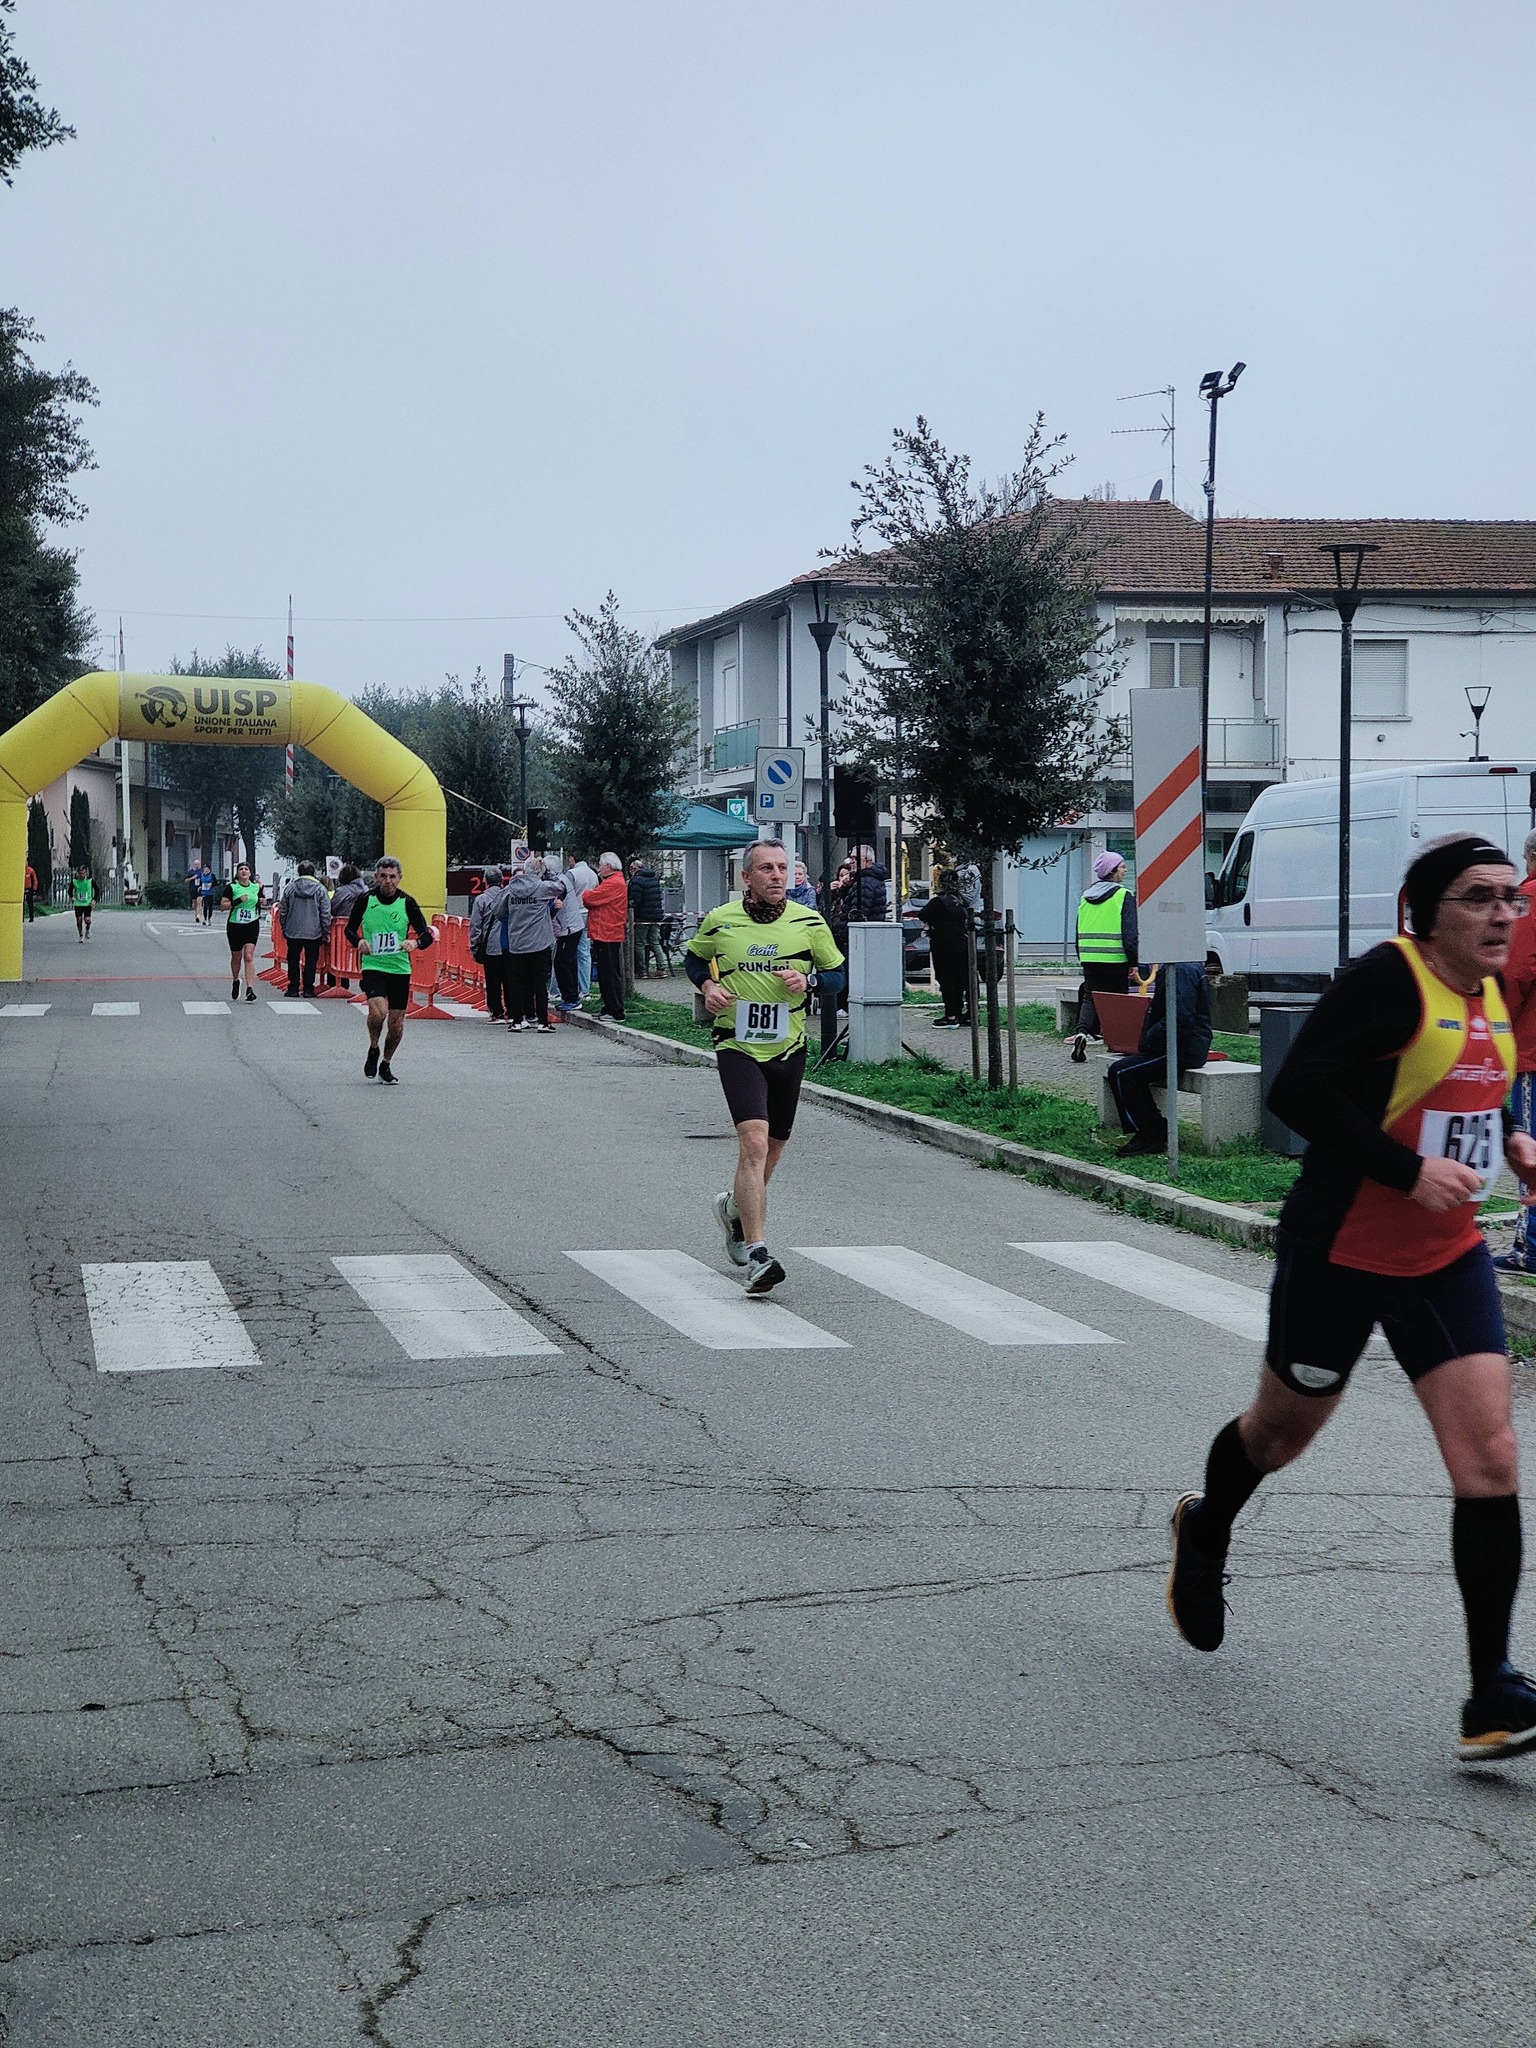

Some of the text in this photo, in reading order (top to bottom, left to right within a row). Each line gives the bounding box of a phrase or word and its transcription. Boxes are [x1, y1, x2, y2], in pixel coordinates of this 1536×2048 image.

[194, 687, 277, 716] UISP
[194, 716, 277, 727] UNIONE ITALIANA
[194, 726, 223, 734] SPORT
[227, 727, 244, 735] PER
[762, 795, 772, 806] P
[378, 933, 396, 947] 775
[748, 1003, 778, 1029] 681
